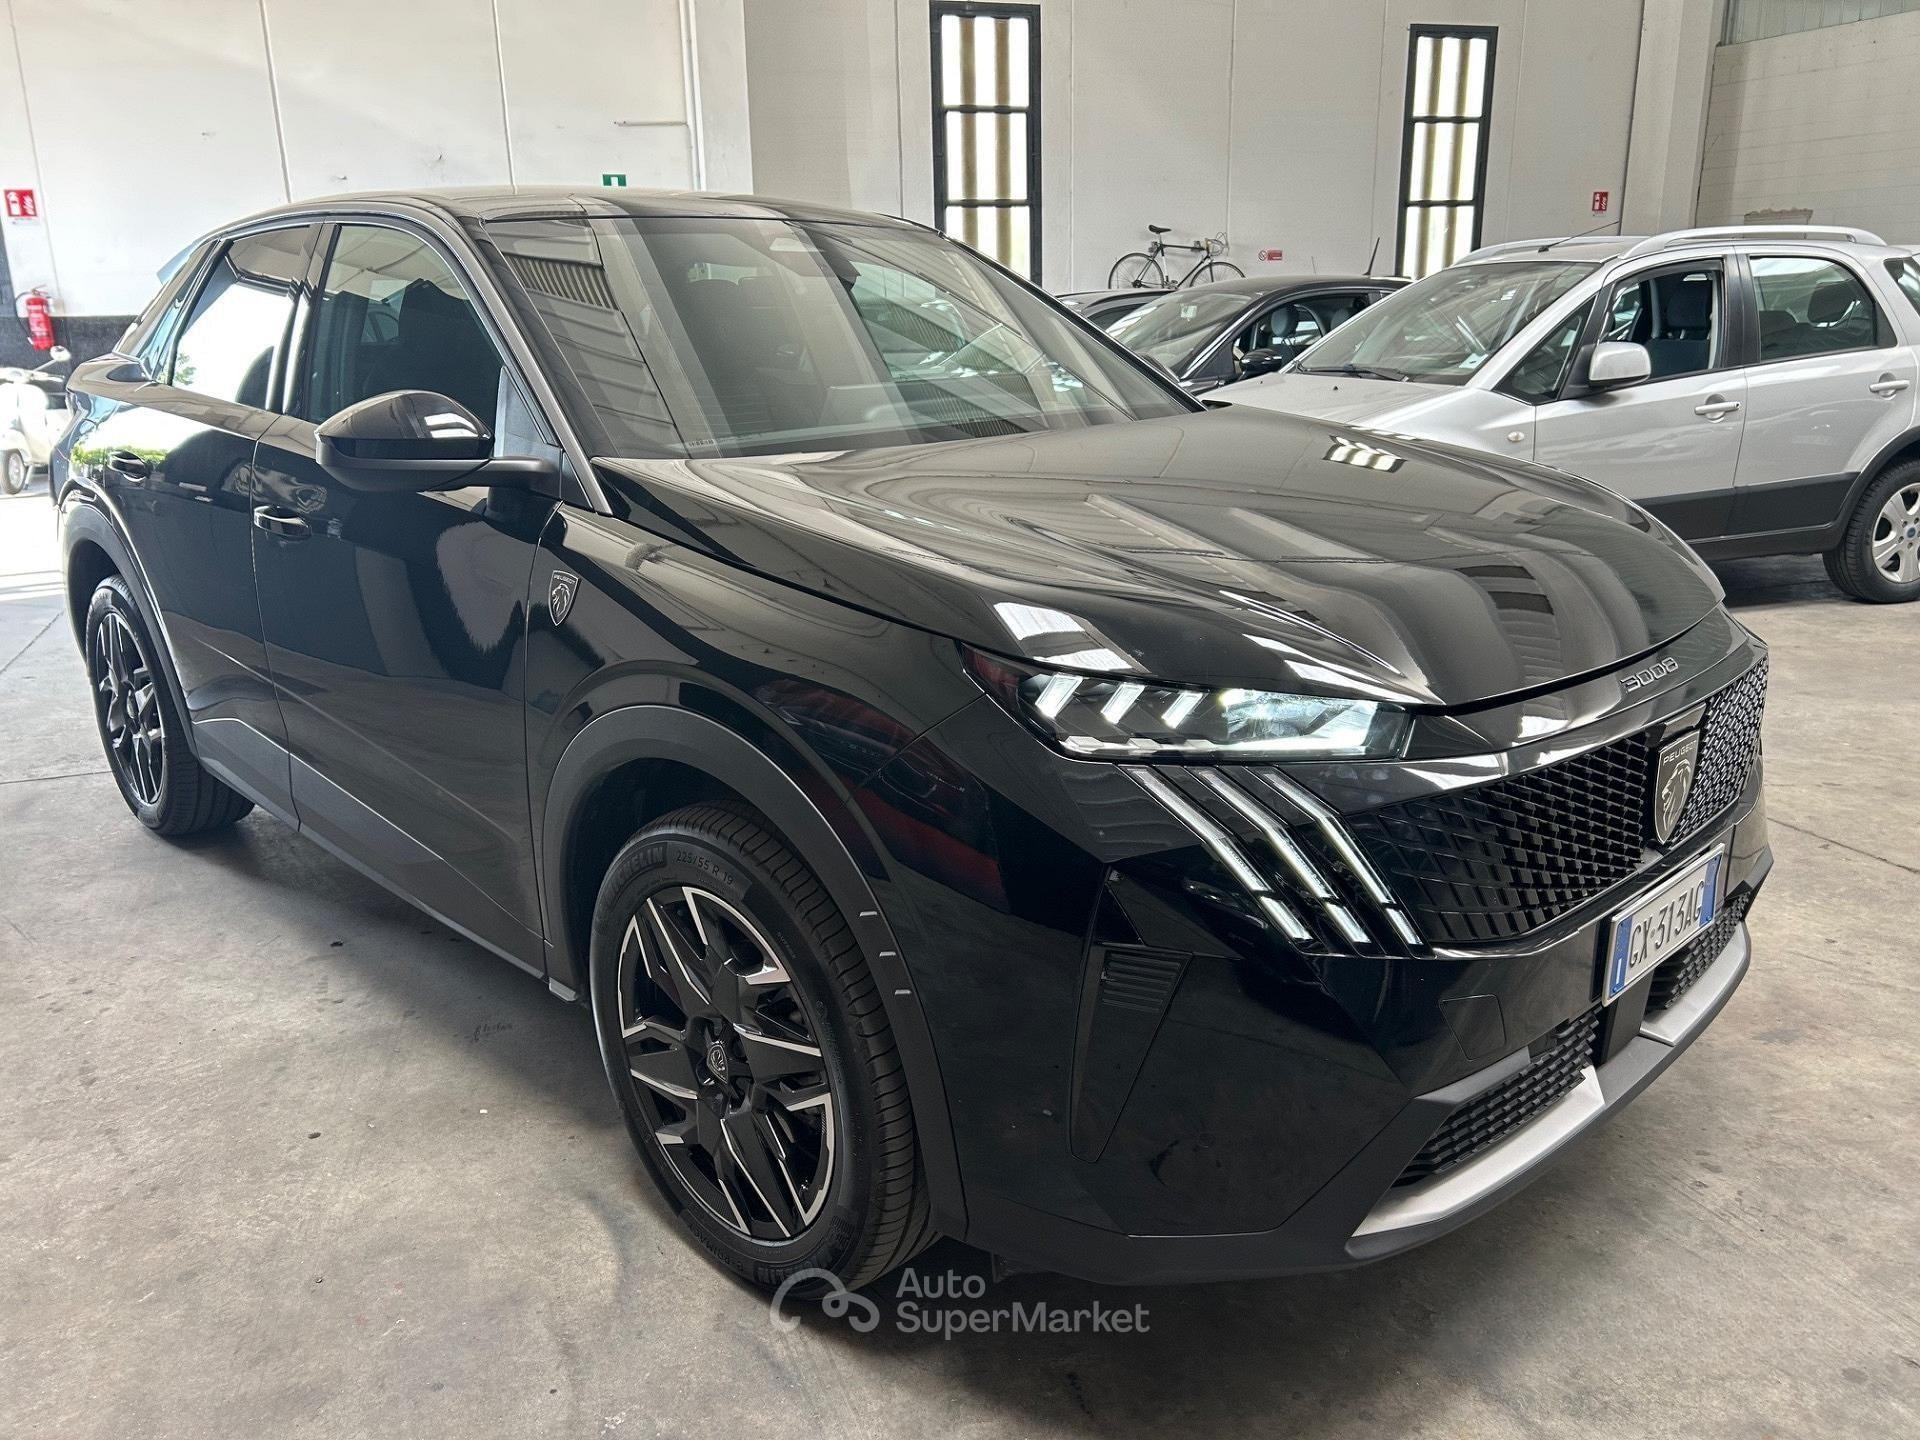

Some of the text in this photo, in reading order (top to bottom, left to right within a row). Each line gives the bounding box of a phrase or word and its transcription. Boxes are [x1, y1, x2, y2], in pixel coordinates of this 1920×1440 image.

[1620, 656, 1679, 692] 3008
[676, 850, 734, 885] 225/55 R 19
